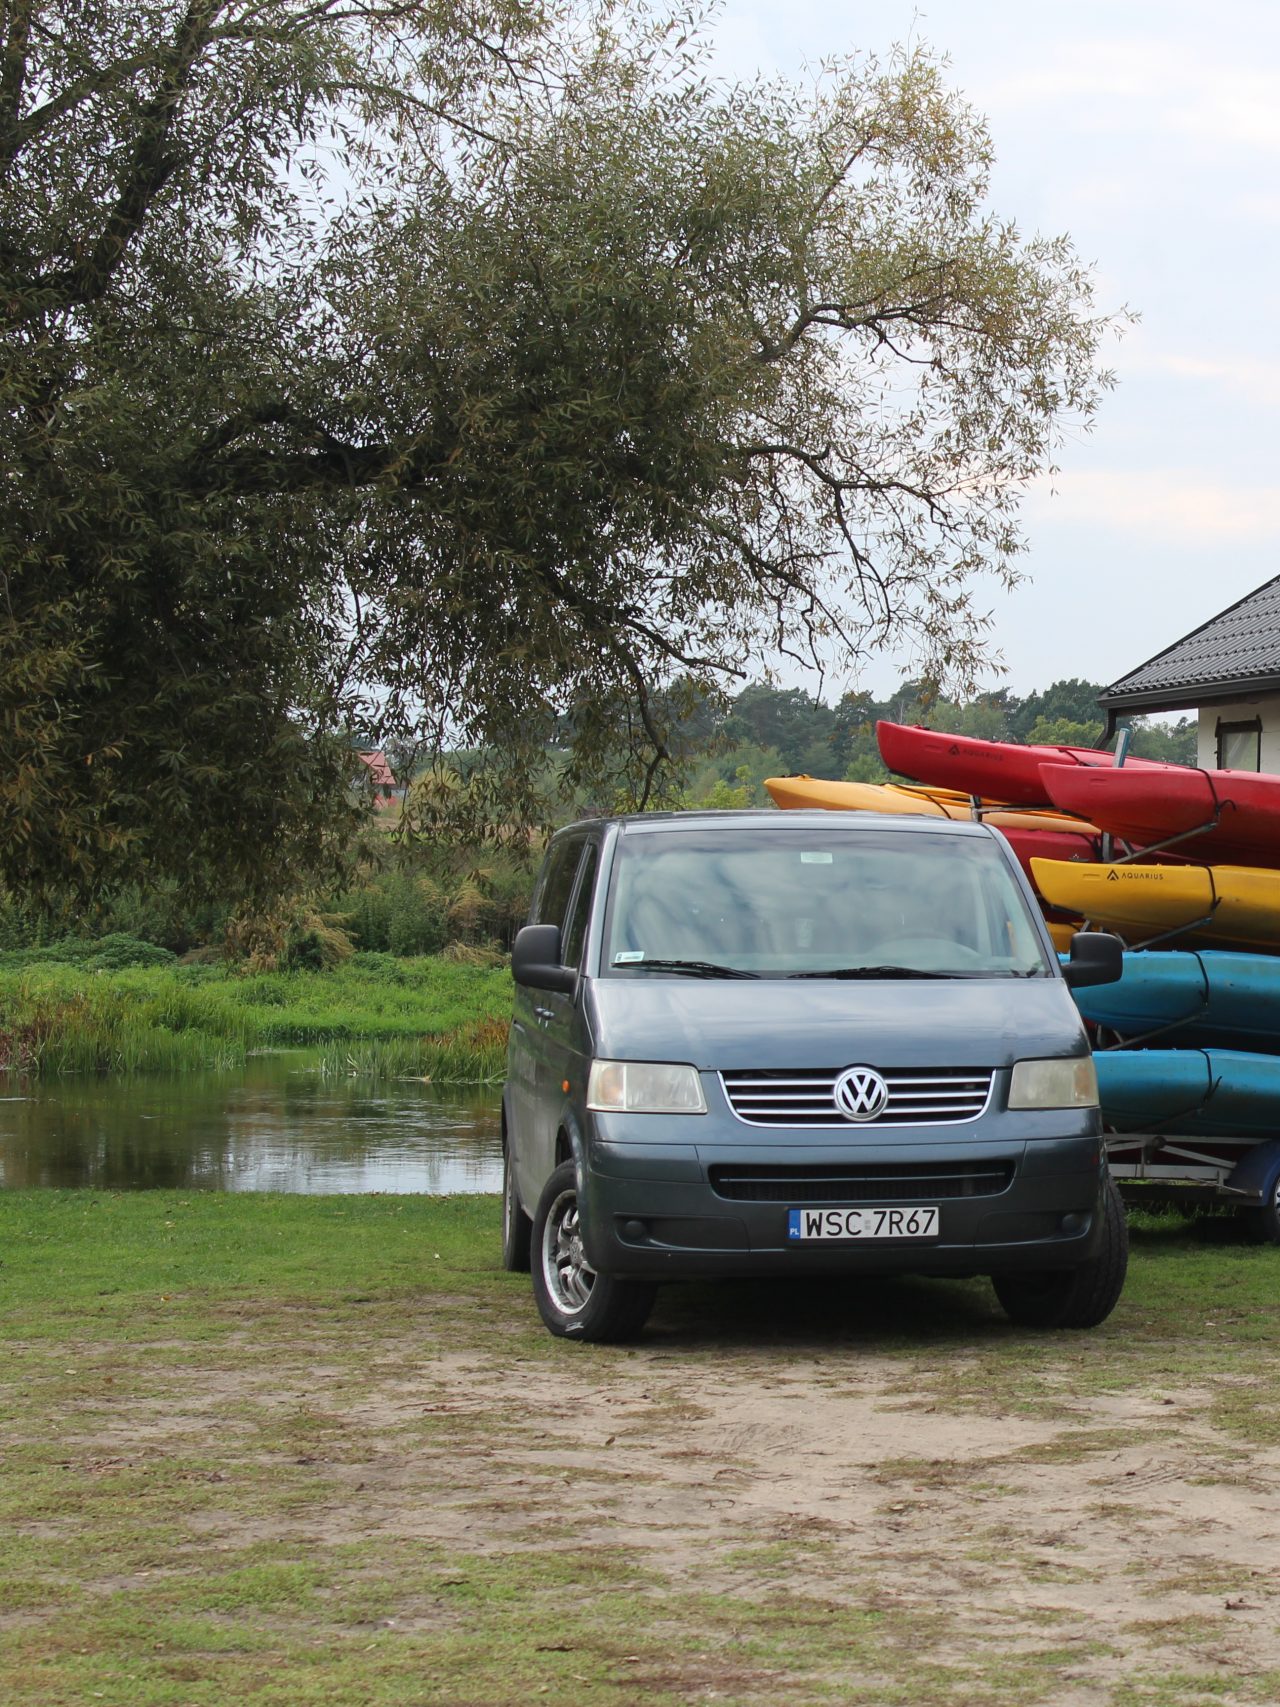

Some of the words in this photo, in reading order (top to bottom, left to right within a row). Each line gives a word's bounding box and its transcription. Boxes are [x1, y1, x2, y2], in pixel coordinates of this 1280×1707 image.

[1121, 872, 1164, 881] AQUARIUS
[805, 1211, 862, 1237] WSC
[873, 1209, 936, 1235] 7R67
[789, 1228, 800, 1236] PL
